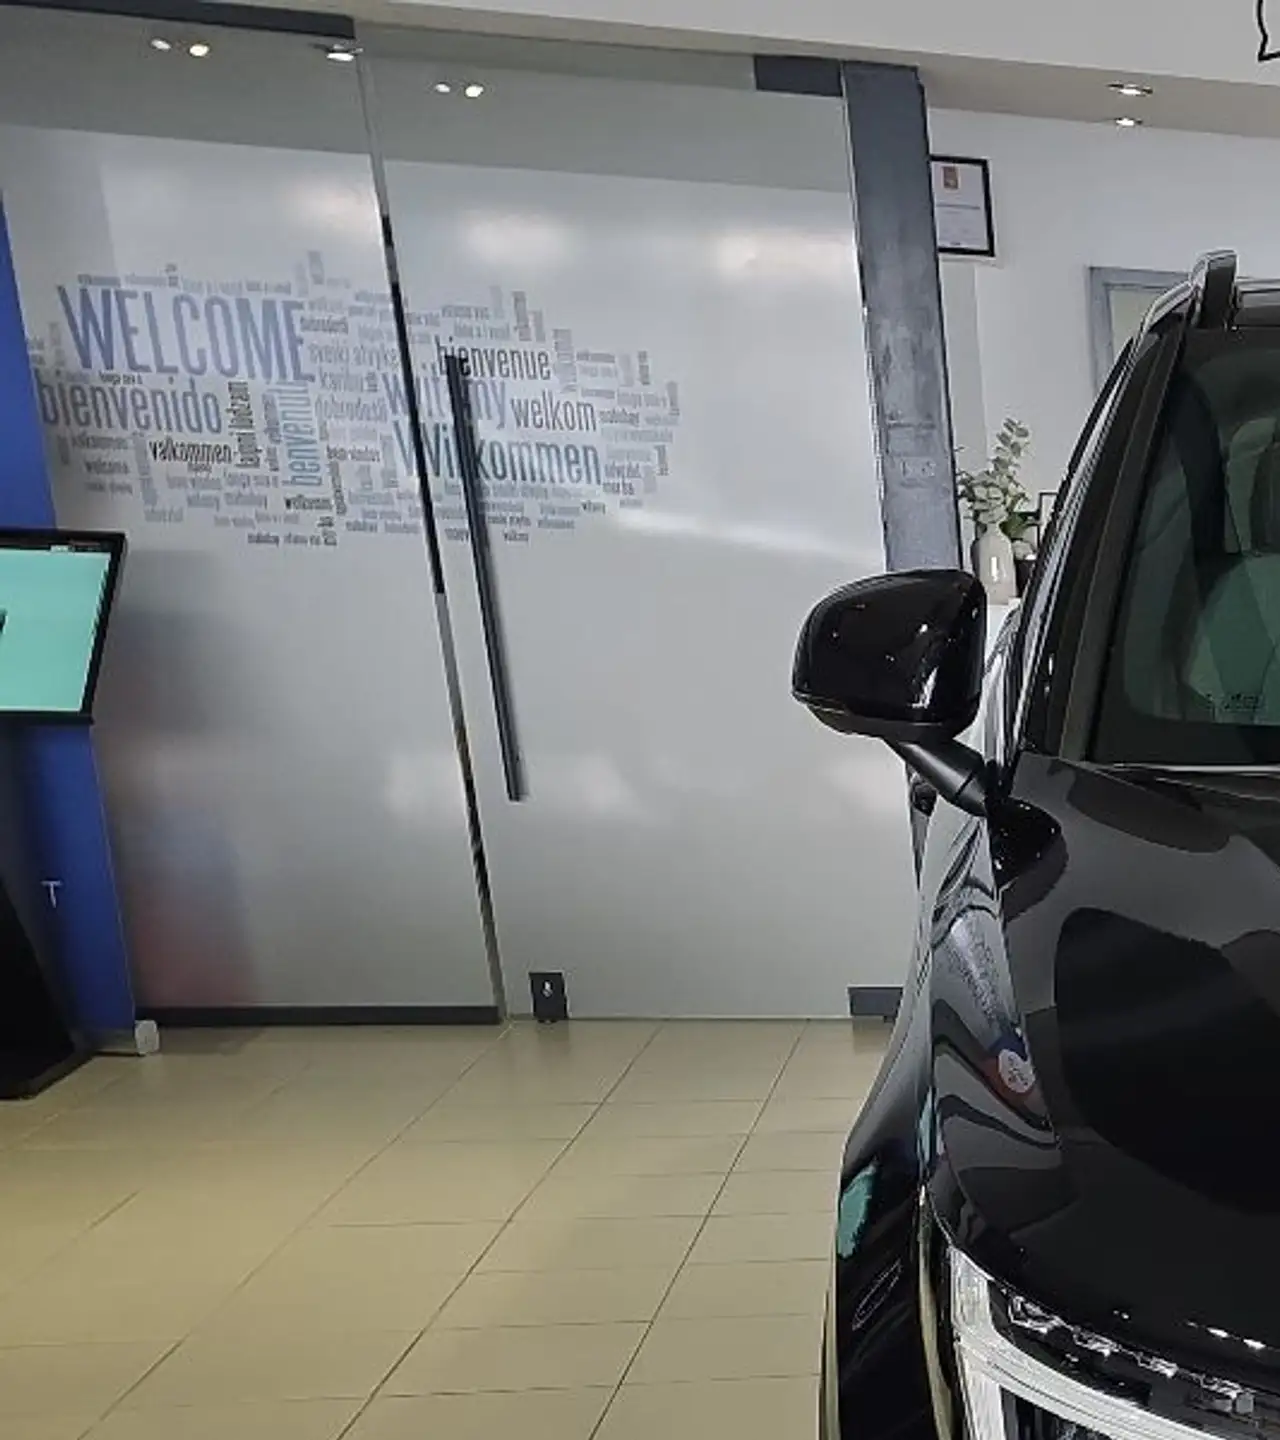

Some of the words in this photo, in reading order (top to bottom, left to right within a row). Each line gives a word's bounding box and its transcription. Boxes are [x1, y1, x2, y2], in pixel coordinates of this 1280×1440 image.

[57, 284, 315, 384] WELCOME
[434, 335, 551, 380] bienvenue
[34, 368, 222, 434] bienvenido
[381, 363, 506, 429] witmy
[511, 390, 598, 432] welkom
[392, 419, 601, 486] Wikommen
